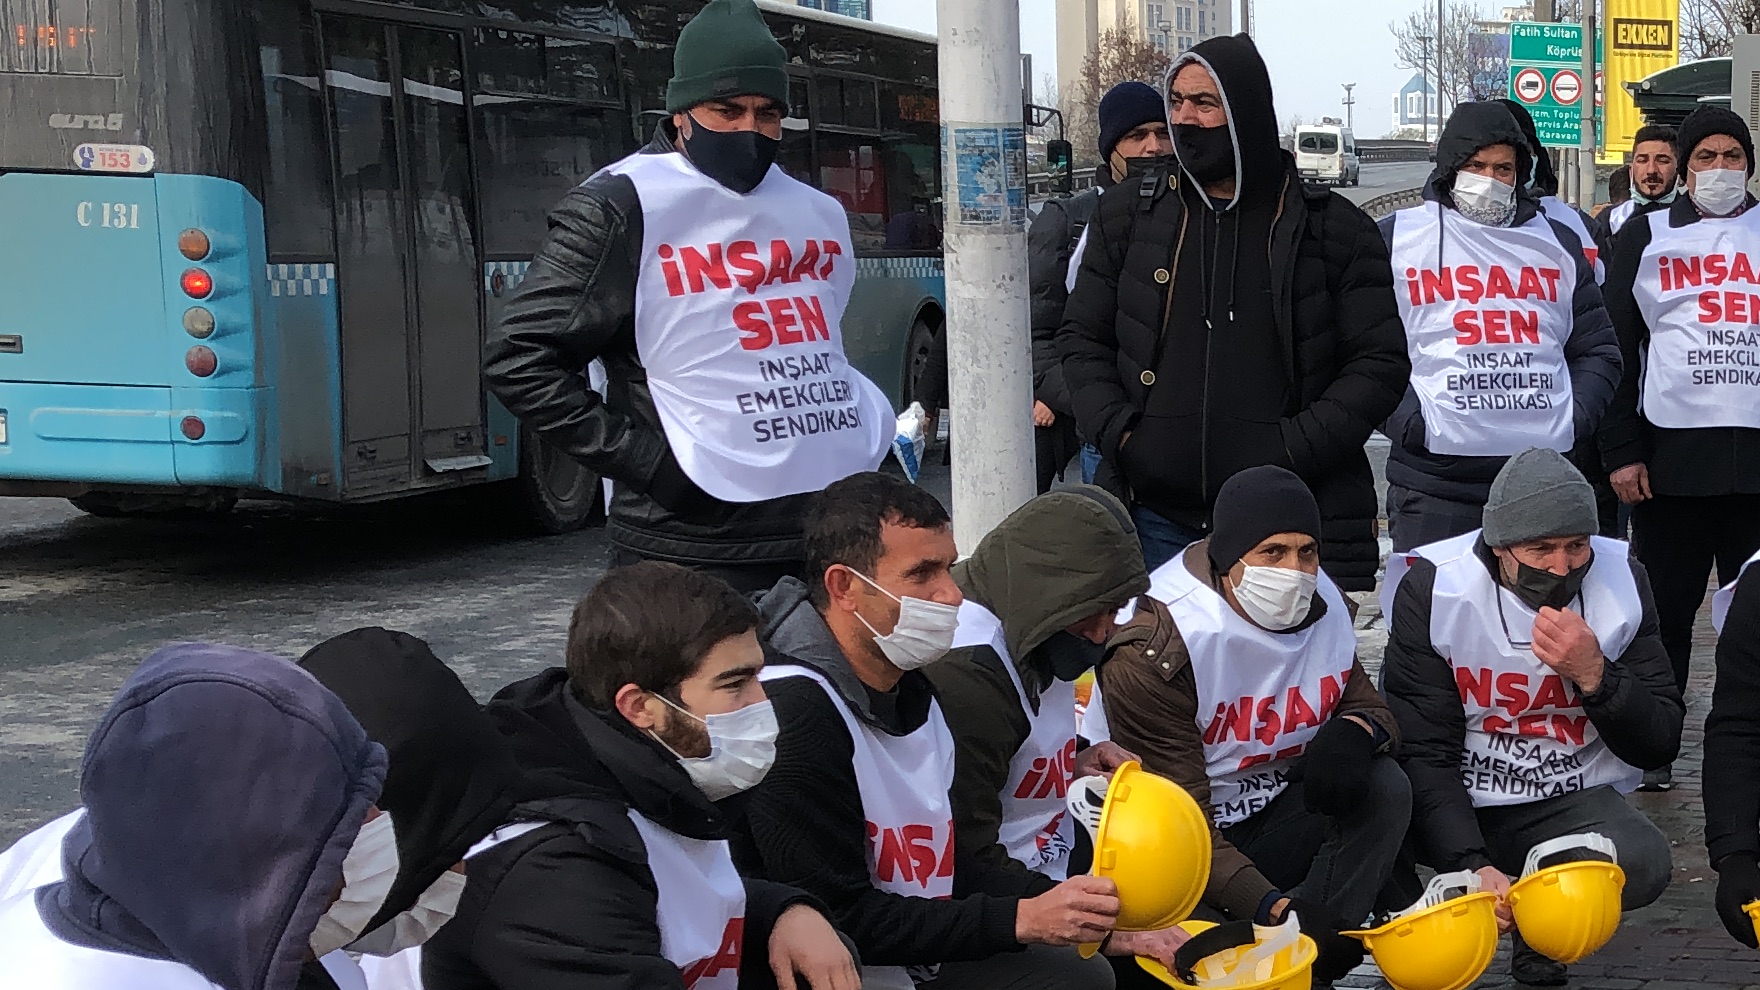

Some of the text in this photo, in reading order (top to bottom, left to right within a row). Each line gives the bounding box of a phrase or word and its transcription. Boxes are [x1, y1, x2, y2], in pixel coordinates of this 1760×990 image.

[1513, 25, 1578, 39] Fatih Sultan
[1617, 23, 1669, 46] EXXEN
[1546, 44, 1583, 60] Köprüs
[1553, 109, 1580, 119] Toplu
[1539, 130, 1578, 140] Karavan
[99, 152, 131, 168] 153
[77, 202, 139, 228] C 131
[658, 239, 841, 297] İNŞAAT
[1406, 265, 1560, 306] İNŞAAT
[732, 296, 830, 350] SEN
[1453, 310, 1540, 345] SEN
[759, 353, 831, 381] İNŞAAT
[1467, 352, 1533, 370] İNŞAAT
[1447, 373, 1553, 391] EMEKÇİLERİ
[1454, 393, 1553, 411] SENDİKASI
[753, 406, 863, 443] SENDİKASI
